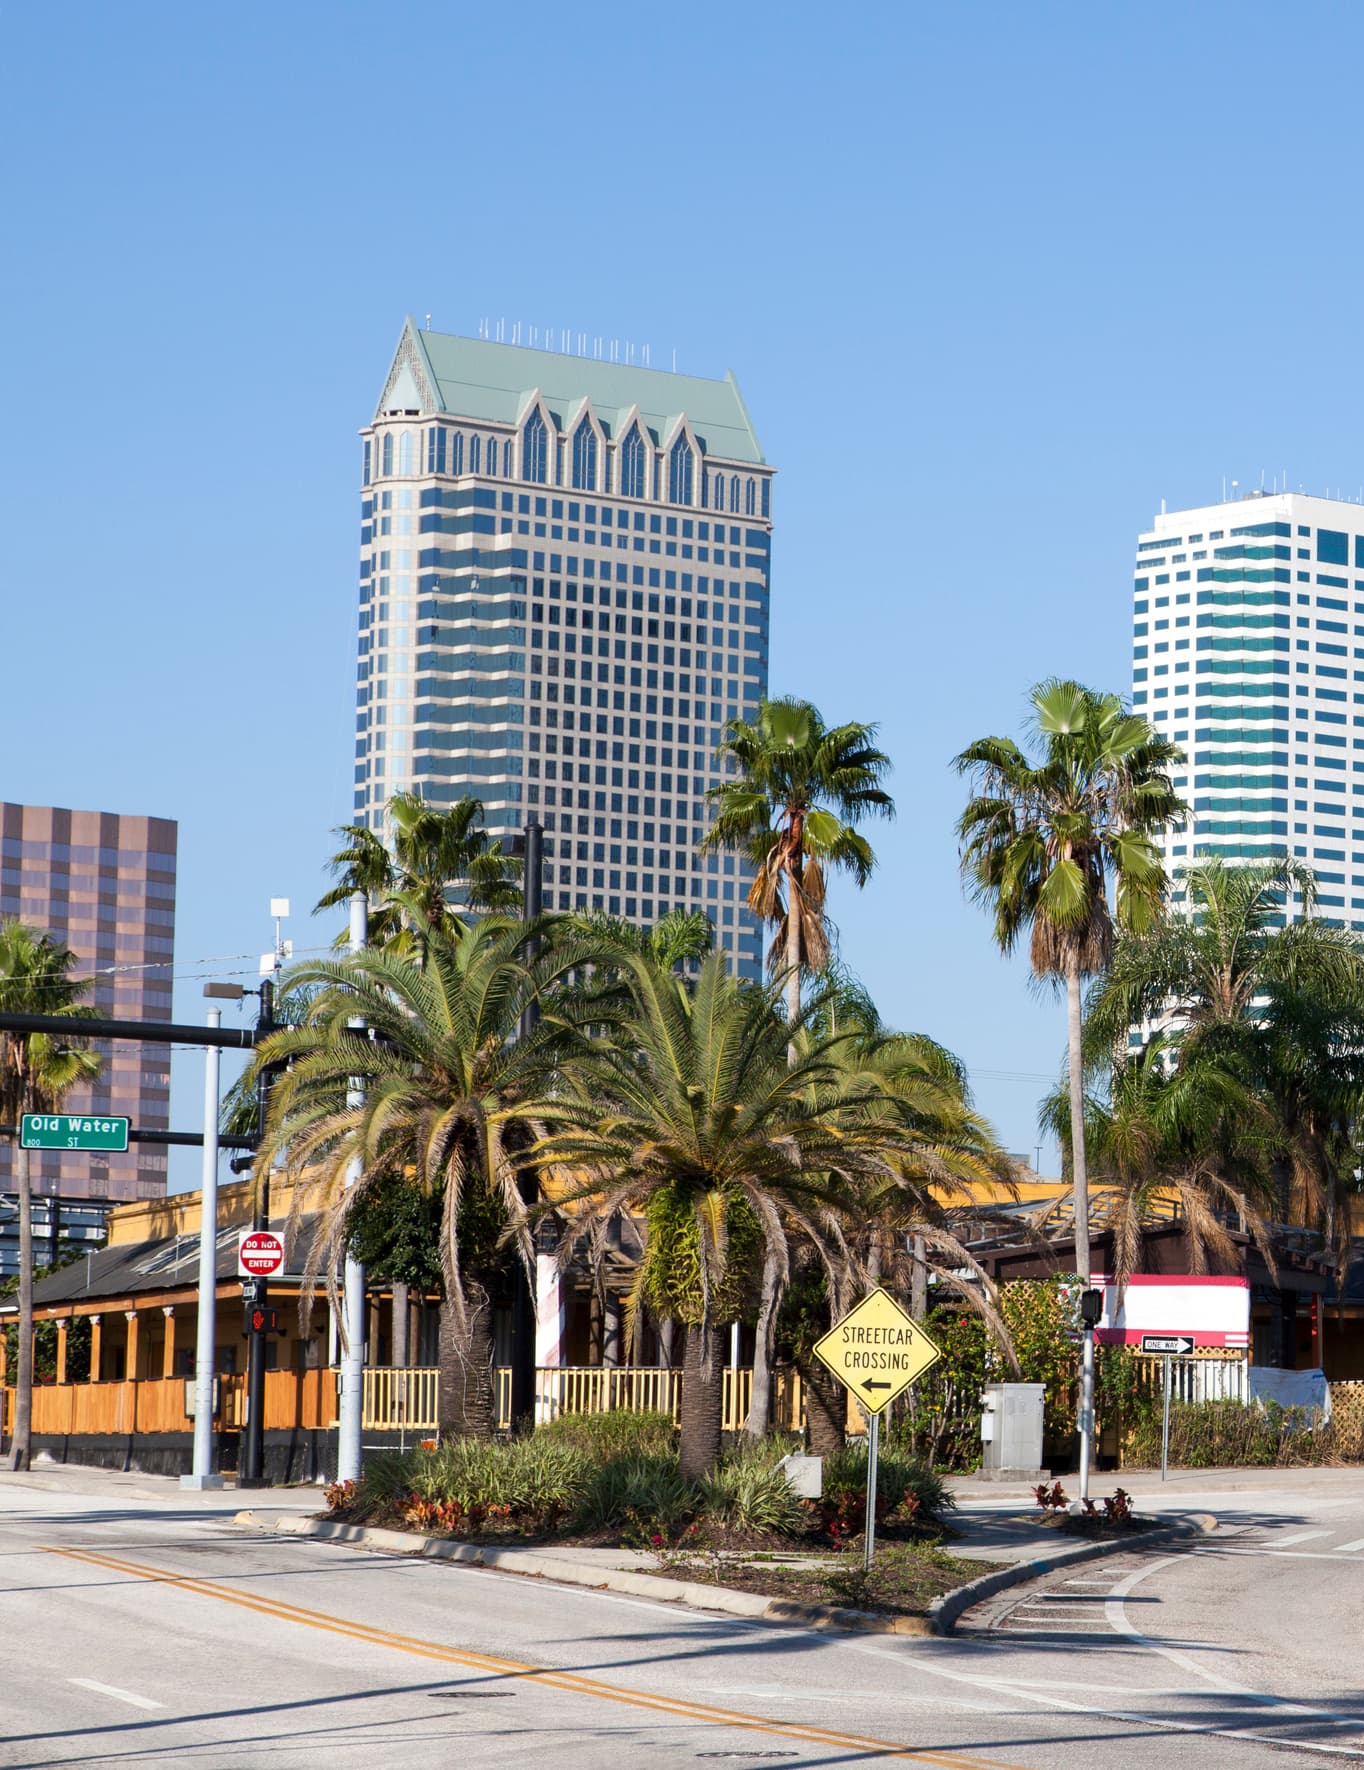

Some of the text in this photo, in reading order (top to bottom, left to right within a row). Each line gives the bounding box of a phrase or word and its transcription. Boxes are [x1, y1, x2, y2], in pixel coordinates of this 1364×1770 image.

[31, 1117, 119, 1133] Old Water
[67, 1137, 79, 1148] ST
[246, 1240, 278, 1249] DO NOT
[248, 1259, 274, 1268] ENTER
[842, 1326, 913, 1346] STREETCAR
[844, 1351, 909, 1371] CROSSING
